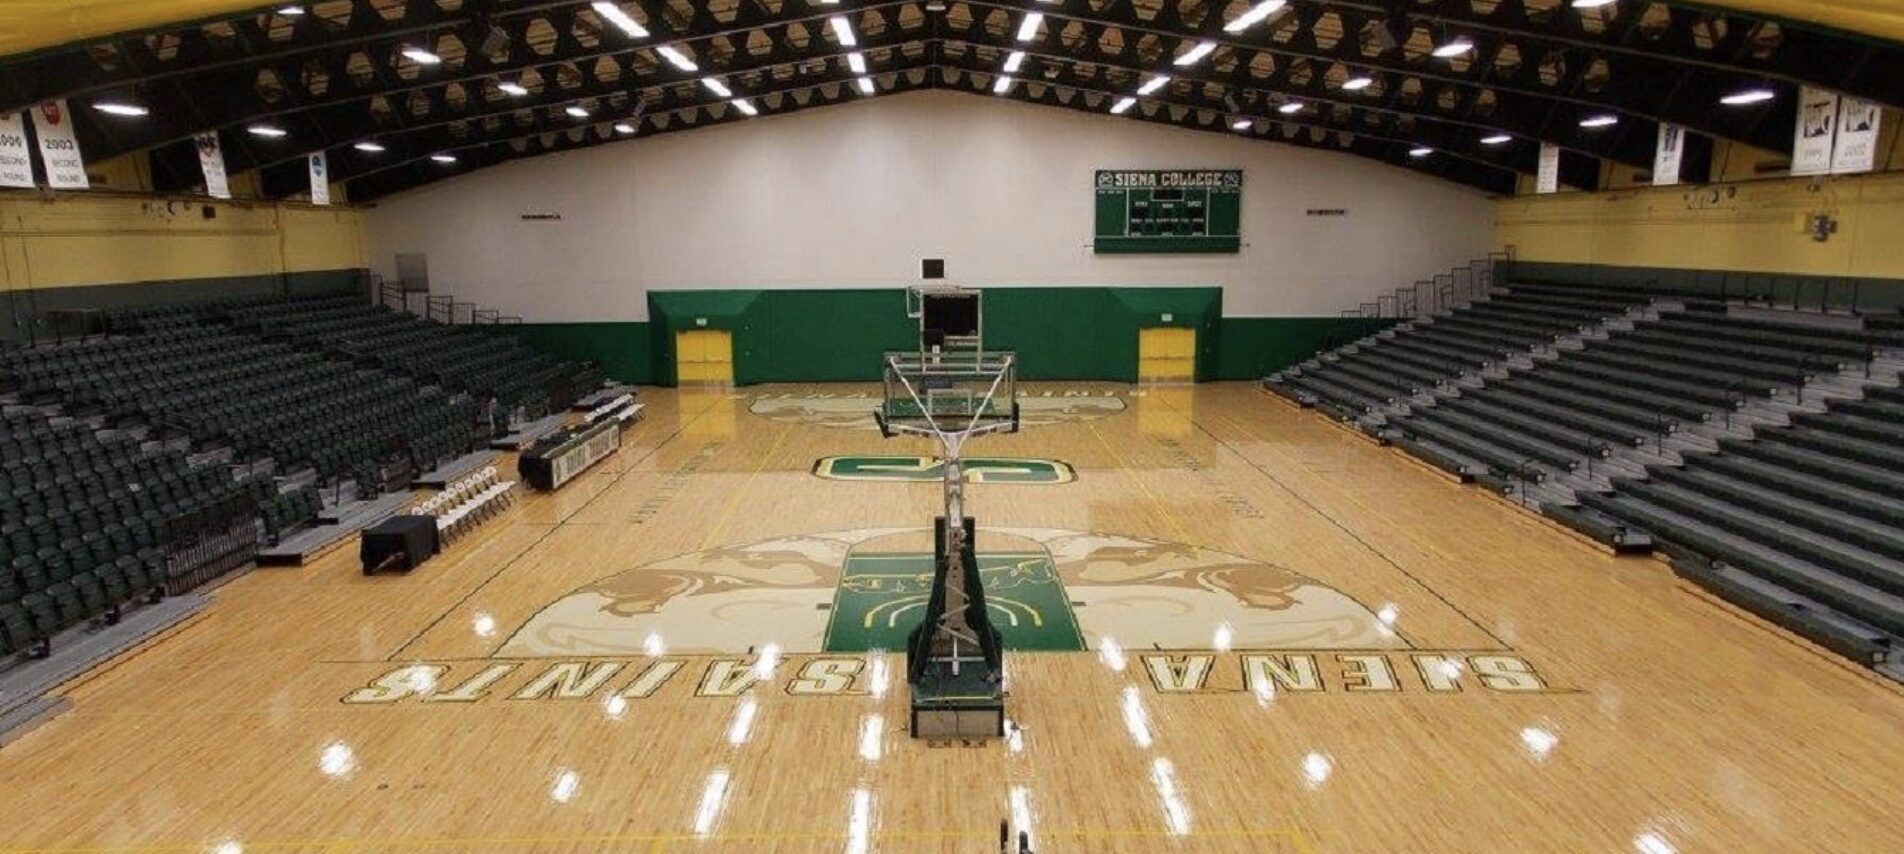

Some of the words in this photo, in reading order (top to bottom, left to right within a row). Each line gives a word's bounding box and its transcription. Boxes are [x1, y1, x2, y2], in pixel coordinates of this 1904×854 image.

[1115, 173, 1157, 186] SIENA
[1161, 172, 1223, 186] COLLEGE
[339, 658, 869, 704] SAINTS
[1140, 653, 1550, 695] SIENA
